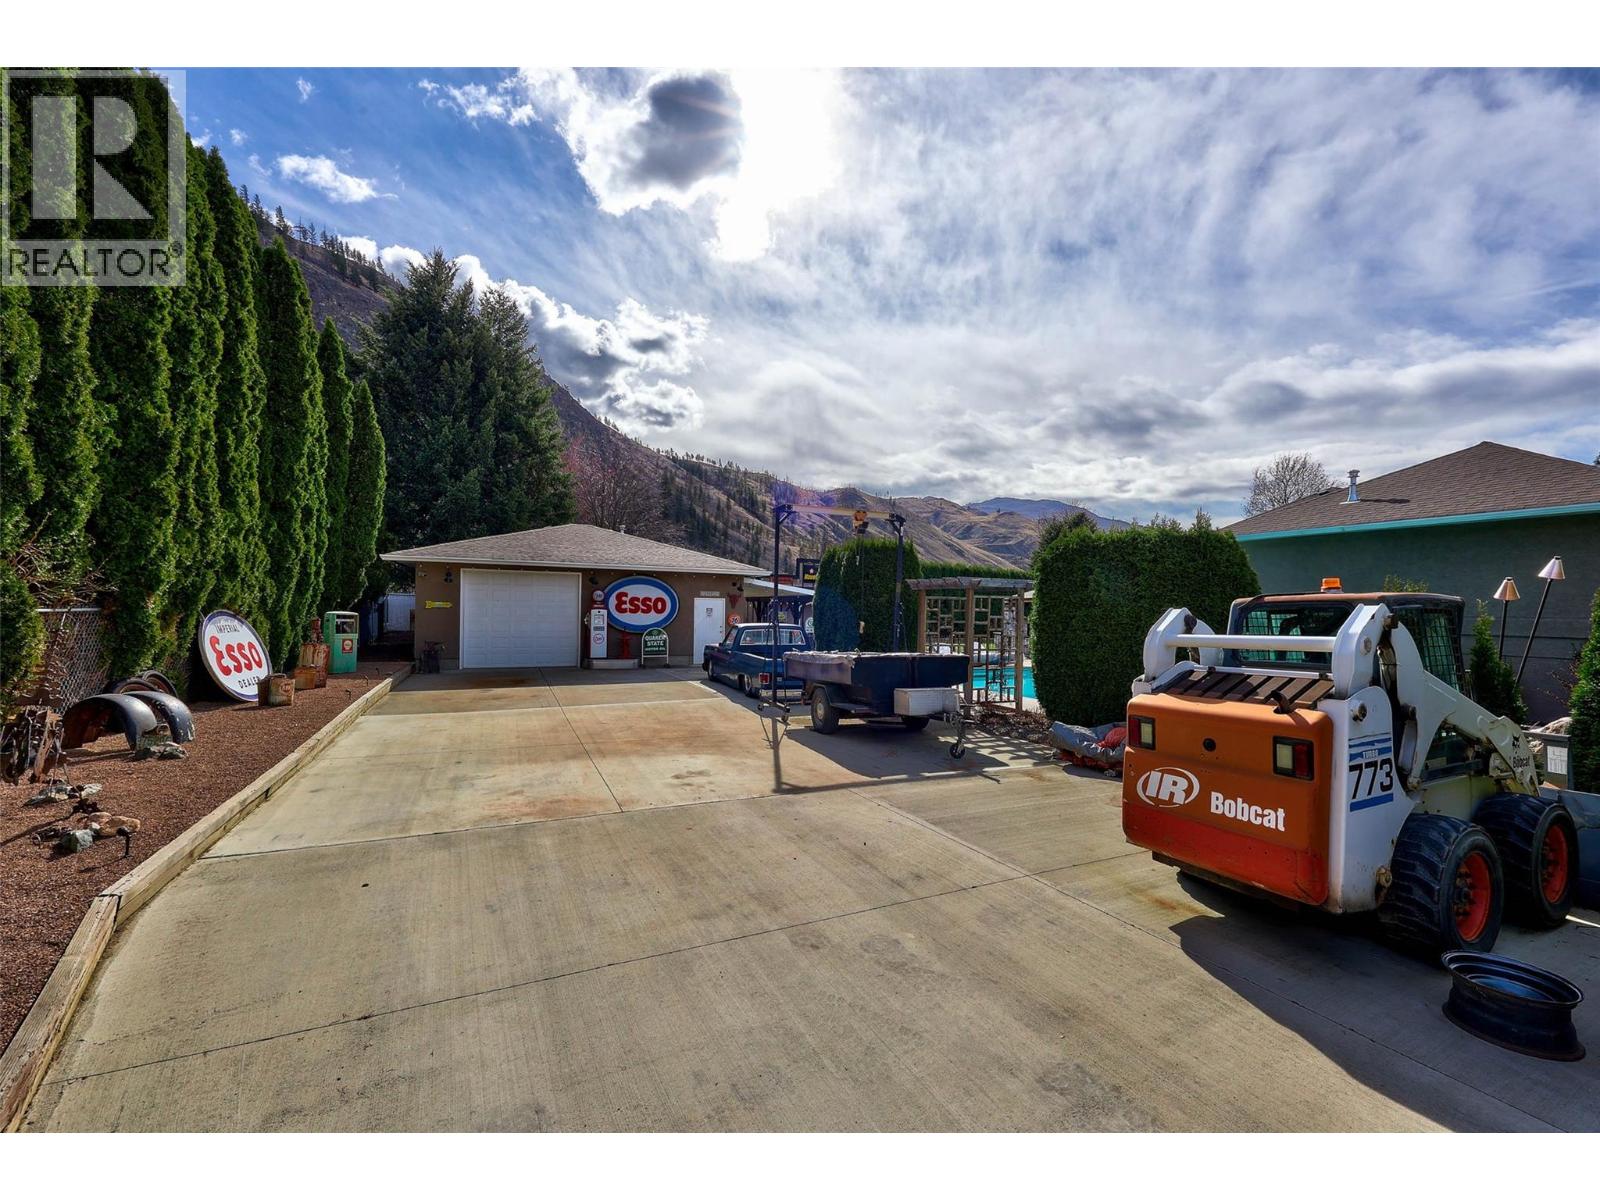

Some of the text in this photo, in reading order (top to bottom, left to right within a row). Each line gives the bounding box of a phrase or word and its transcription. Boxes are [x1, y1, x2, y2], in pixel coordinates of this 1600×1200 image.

[215, 623, 240, 634] IMPERIAL
[1145, 770, 1189, 805] IR
[1349, 757, 1394, 800] 773
[1210, 791, 1286, 833] Bobcat
